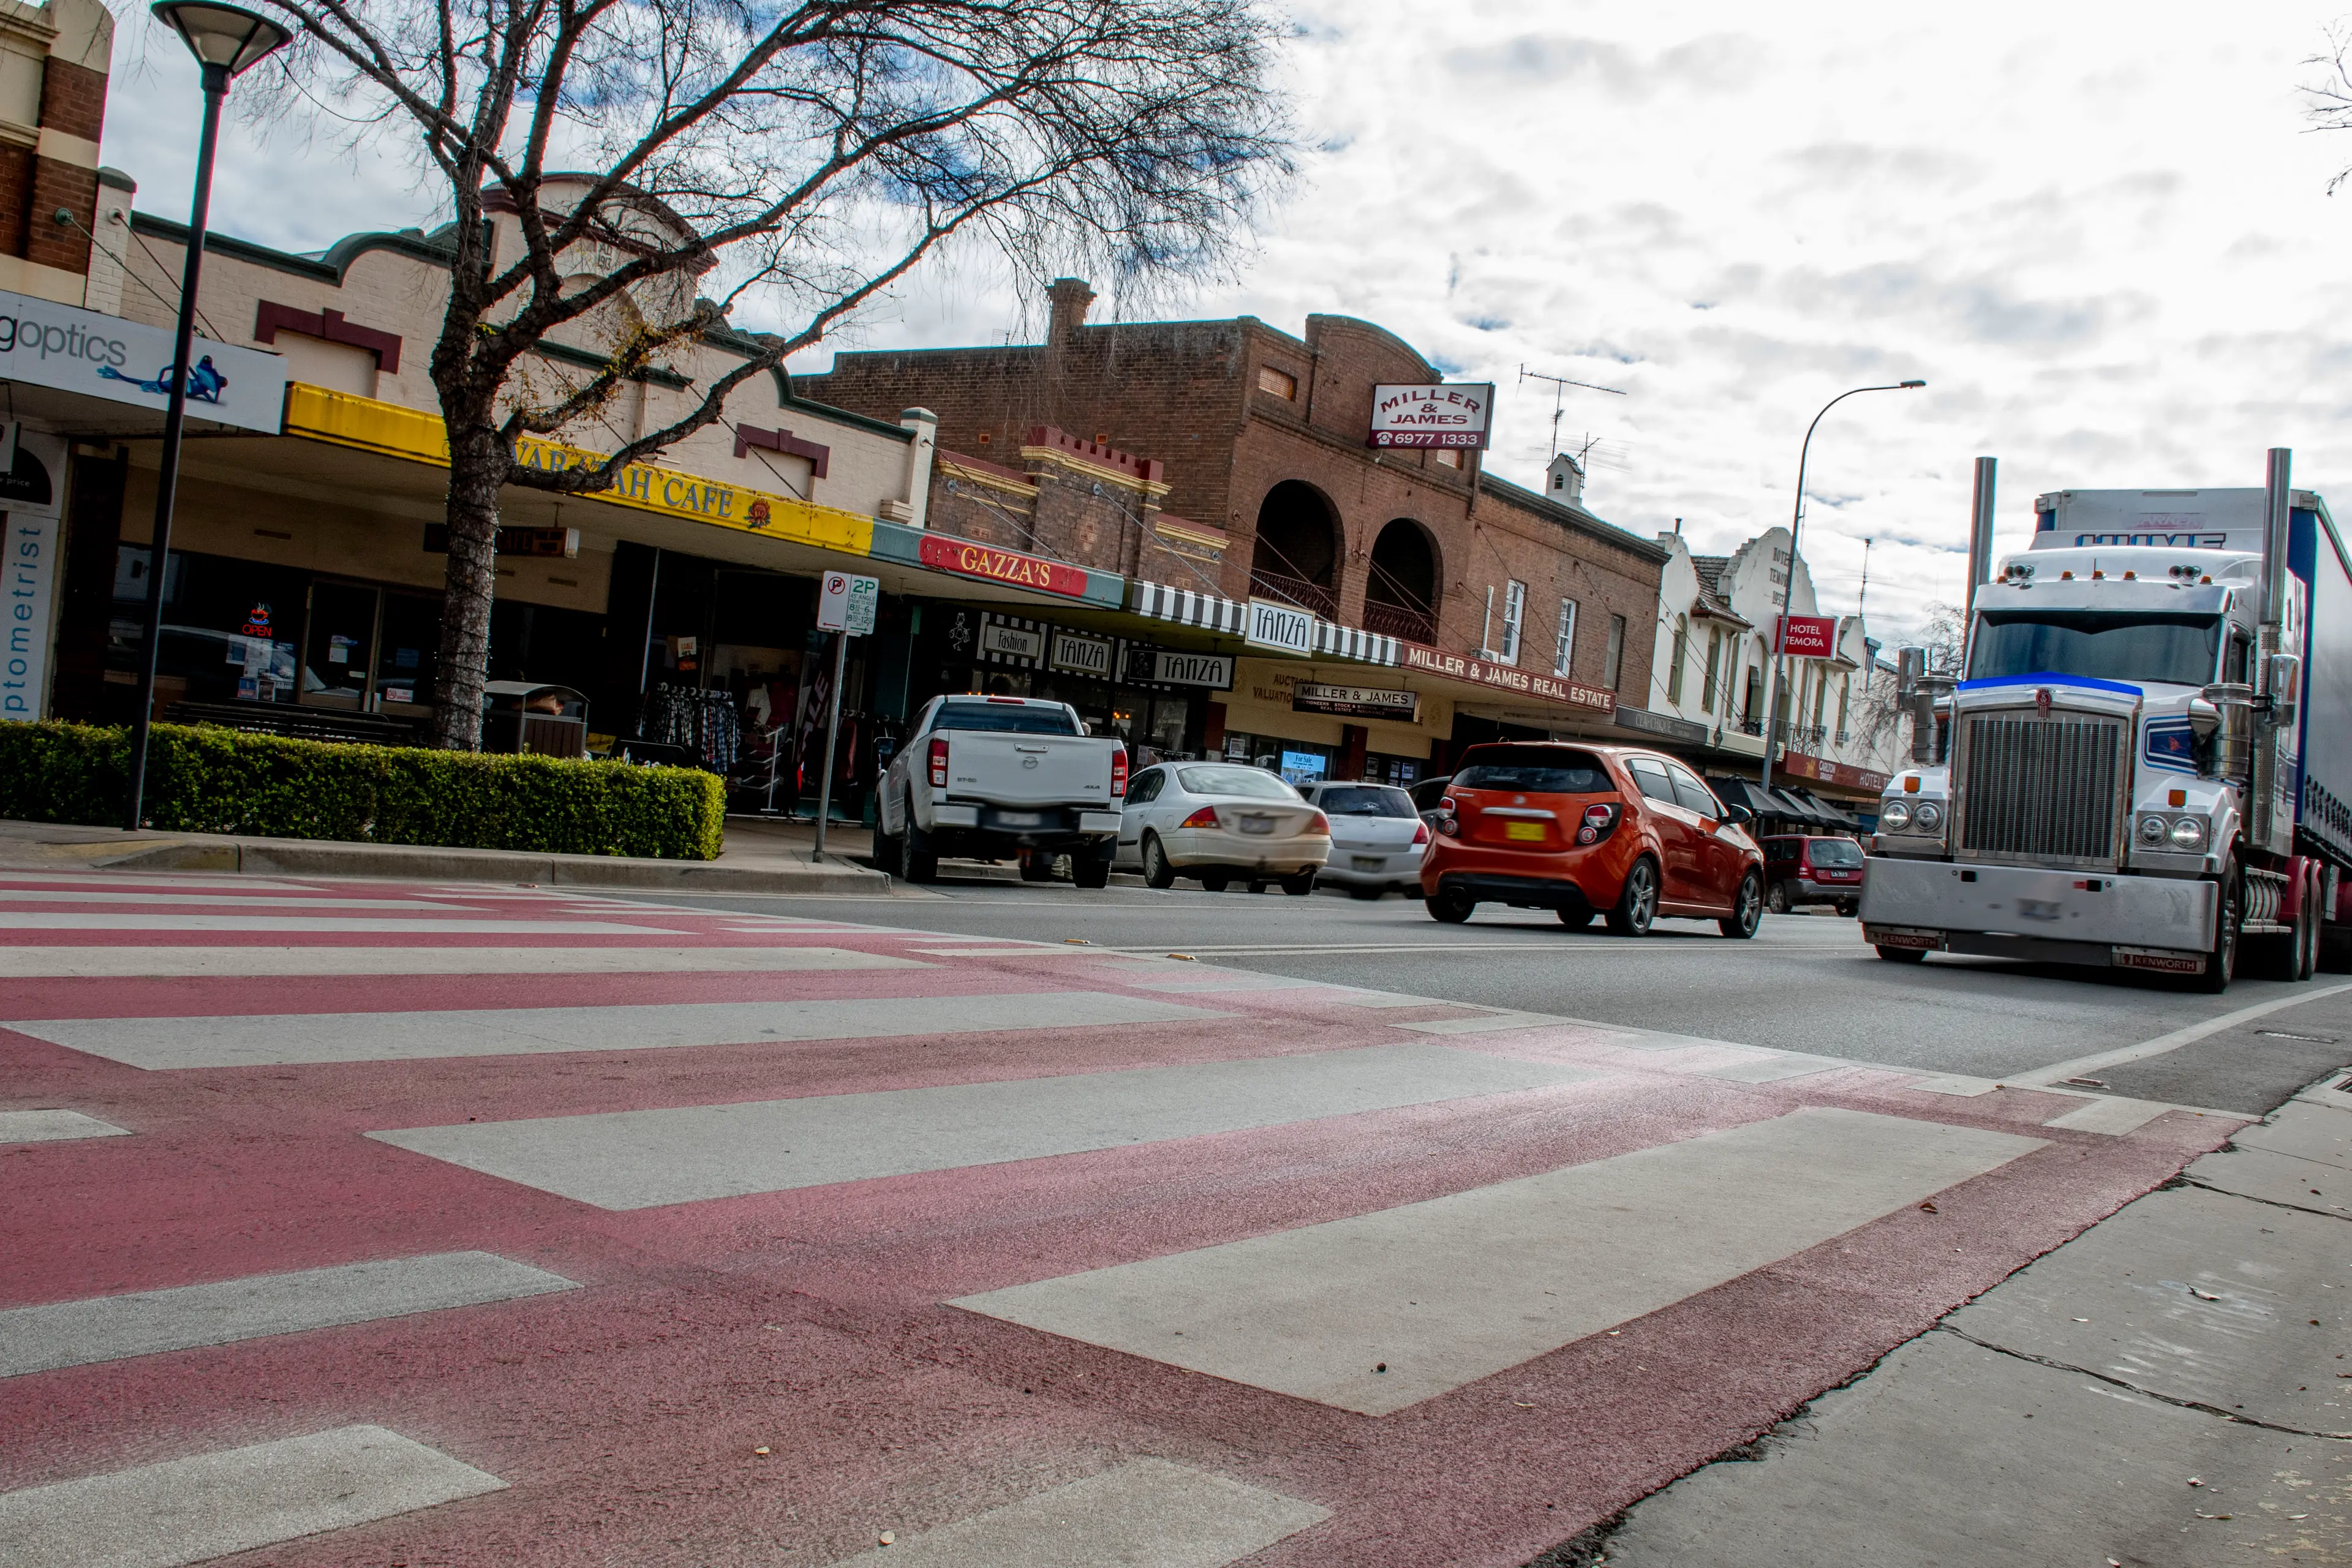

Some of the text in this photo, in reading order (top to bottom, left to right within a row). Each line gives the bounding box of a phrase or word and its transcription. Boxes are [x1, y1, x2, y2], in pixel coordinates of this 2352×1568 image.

[0, 315, 126, 366] goptics
[1381, 389, 1480, 414] MILLER
[1420, 404, 1438, 413] &
[1390, 415, 1468, 424] JAMES
[1395, 433, 1477, 445] 6977 1333
[7, 478, 30, 487] price
[663, 477, 734, 518] CAFE
[1773, 548, 1790, 567] HOTE
[961, 547, 1050, 587] GAZZA'S
[853, 579, 875, 594] 2P
[3, 527, 40, 722] ptometrist
[243, 624, 273, 637] OPEN
[1256, 608, 1306, 647] TANZA
[1790, 624, 1821, 635] HOTEL
[998, 630, 1028, 652] Fashion
[1785, 636, 1824, 647] TEMORA
[1060, 638, 1105, 669] TANZA
[1164, 656, 1223, 683] TANZA
[1409, 647, 1611, 709] MILLER & JAMES REAL ESTATE
[1302, 687, 1408, 704] MILLER & JAMES
[1860, 772, 1882, 790] HOTEL
[1883, 934, 1936, 947] KENWORTH
[2135, 956, 2195, 970] KENWORTH
